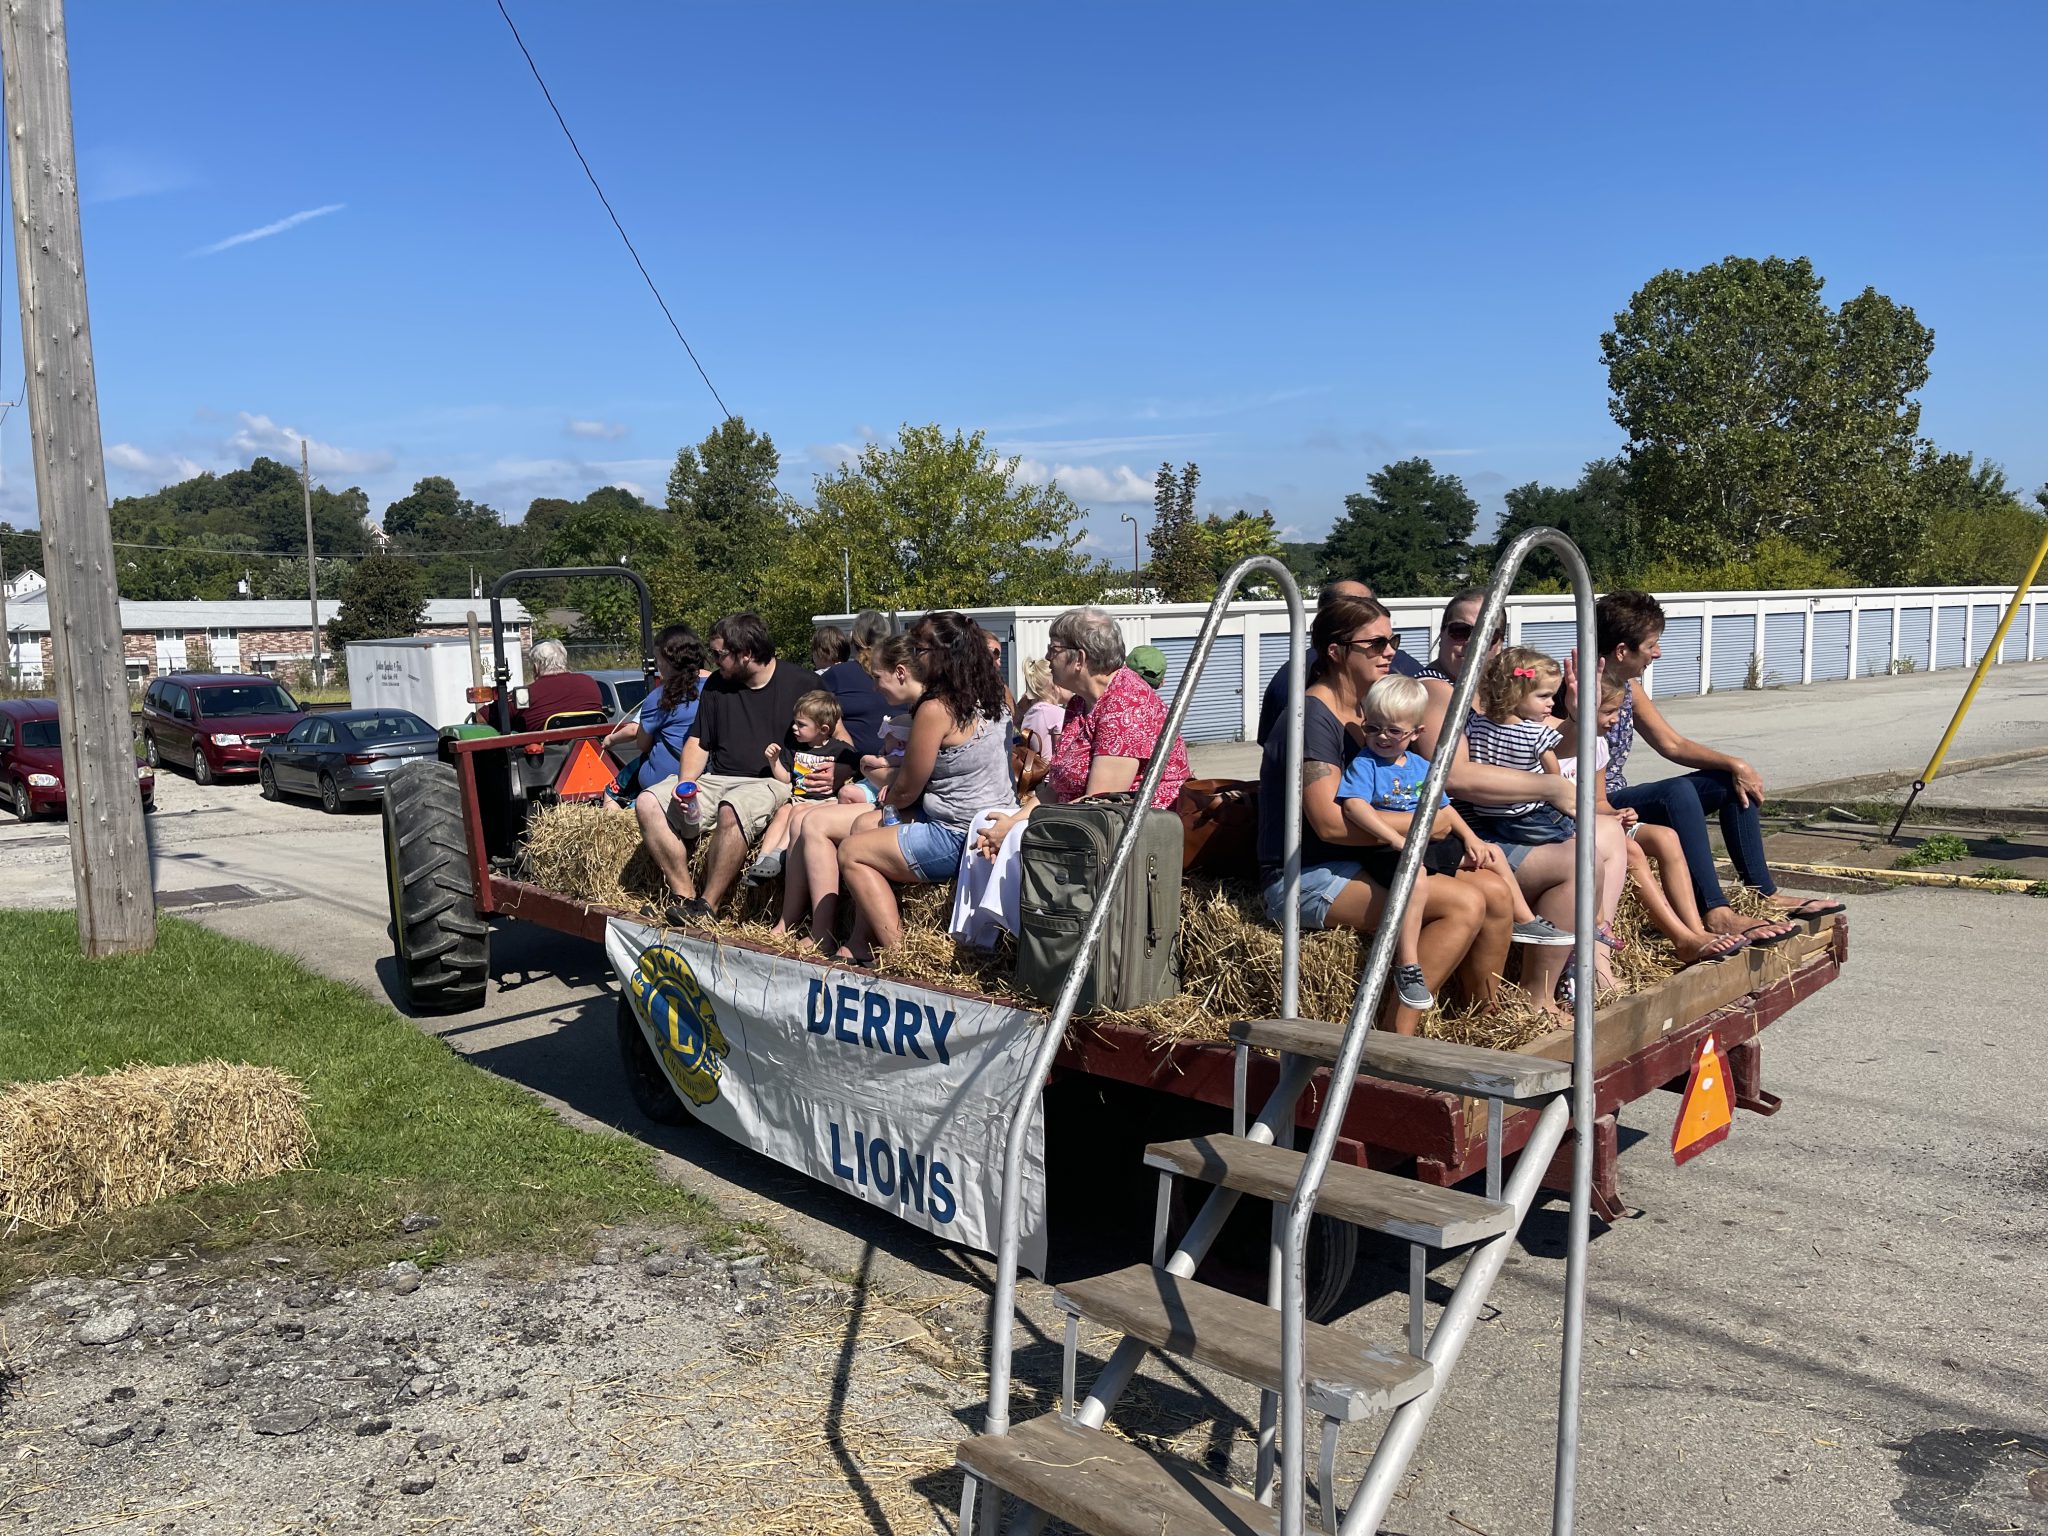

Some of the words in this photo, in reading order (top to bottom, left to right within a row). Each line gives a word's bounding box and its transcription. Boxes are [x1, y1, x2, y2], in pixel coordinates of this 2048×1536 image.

[1008, 624, 1015, 643] A
[807, 978, 956, 1065] DERRY
[829, 1122, 956, 1224] LIONS
